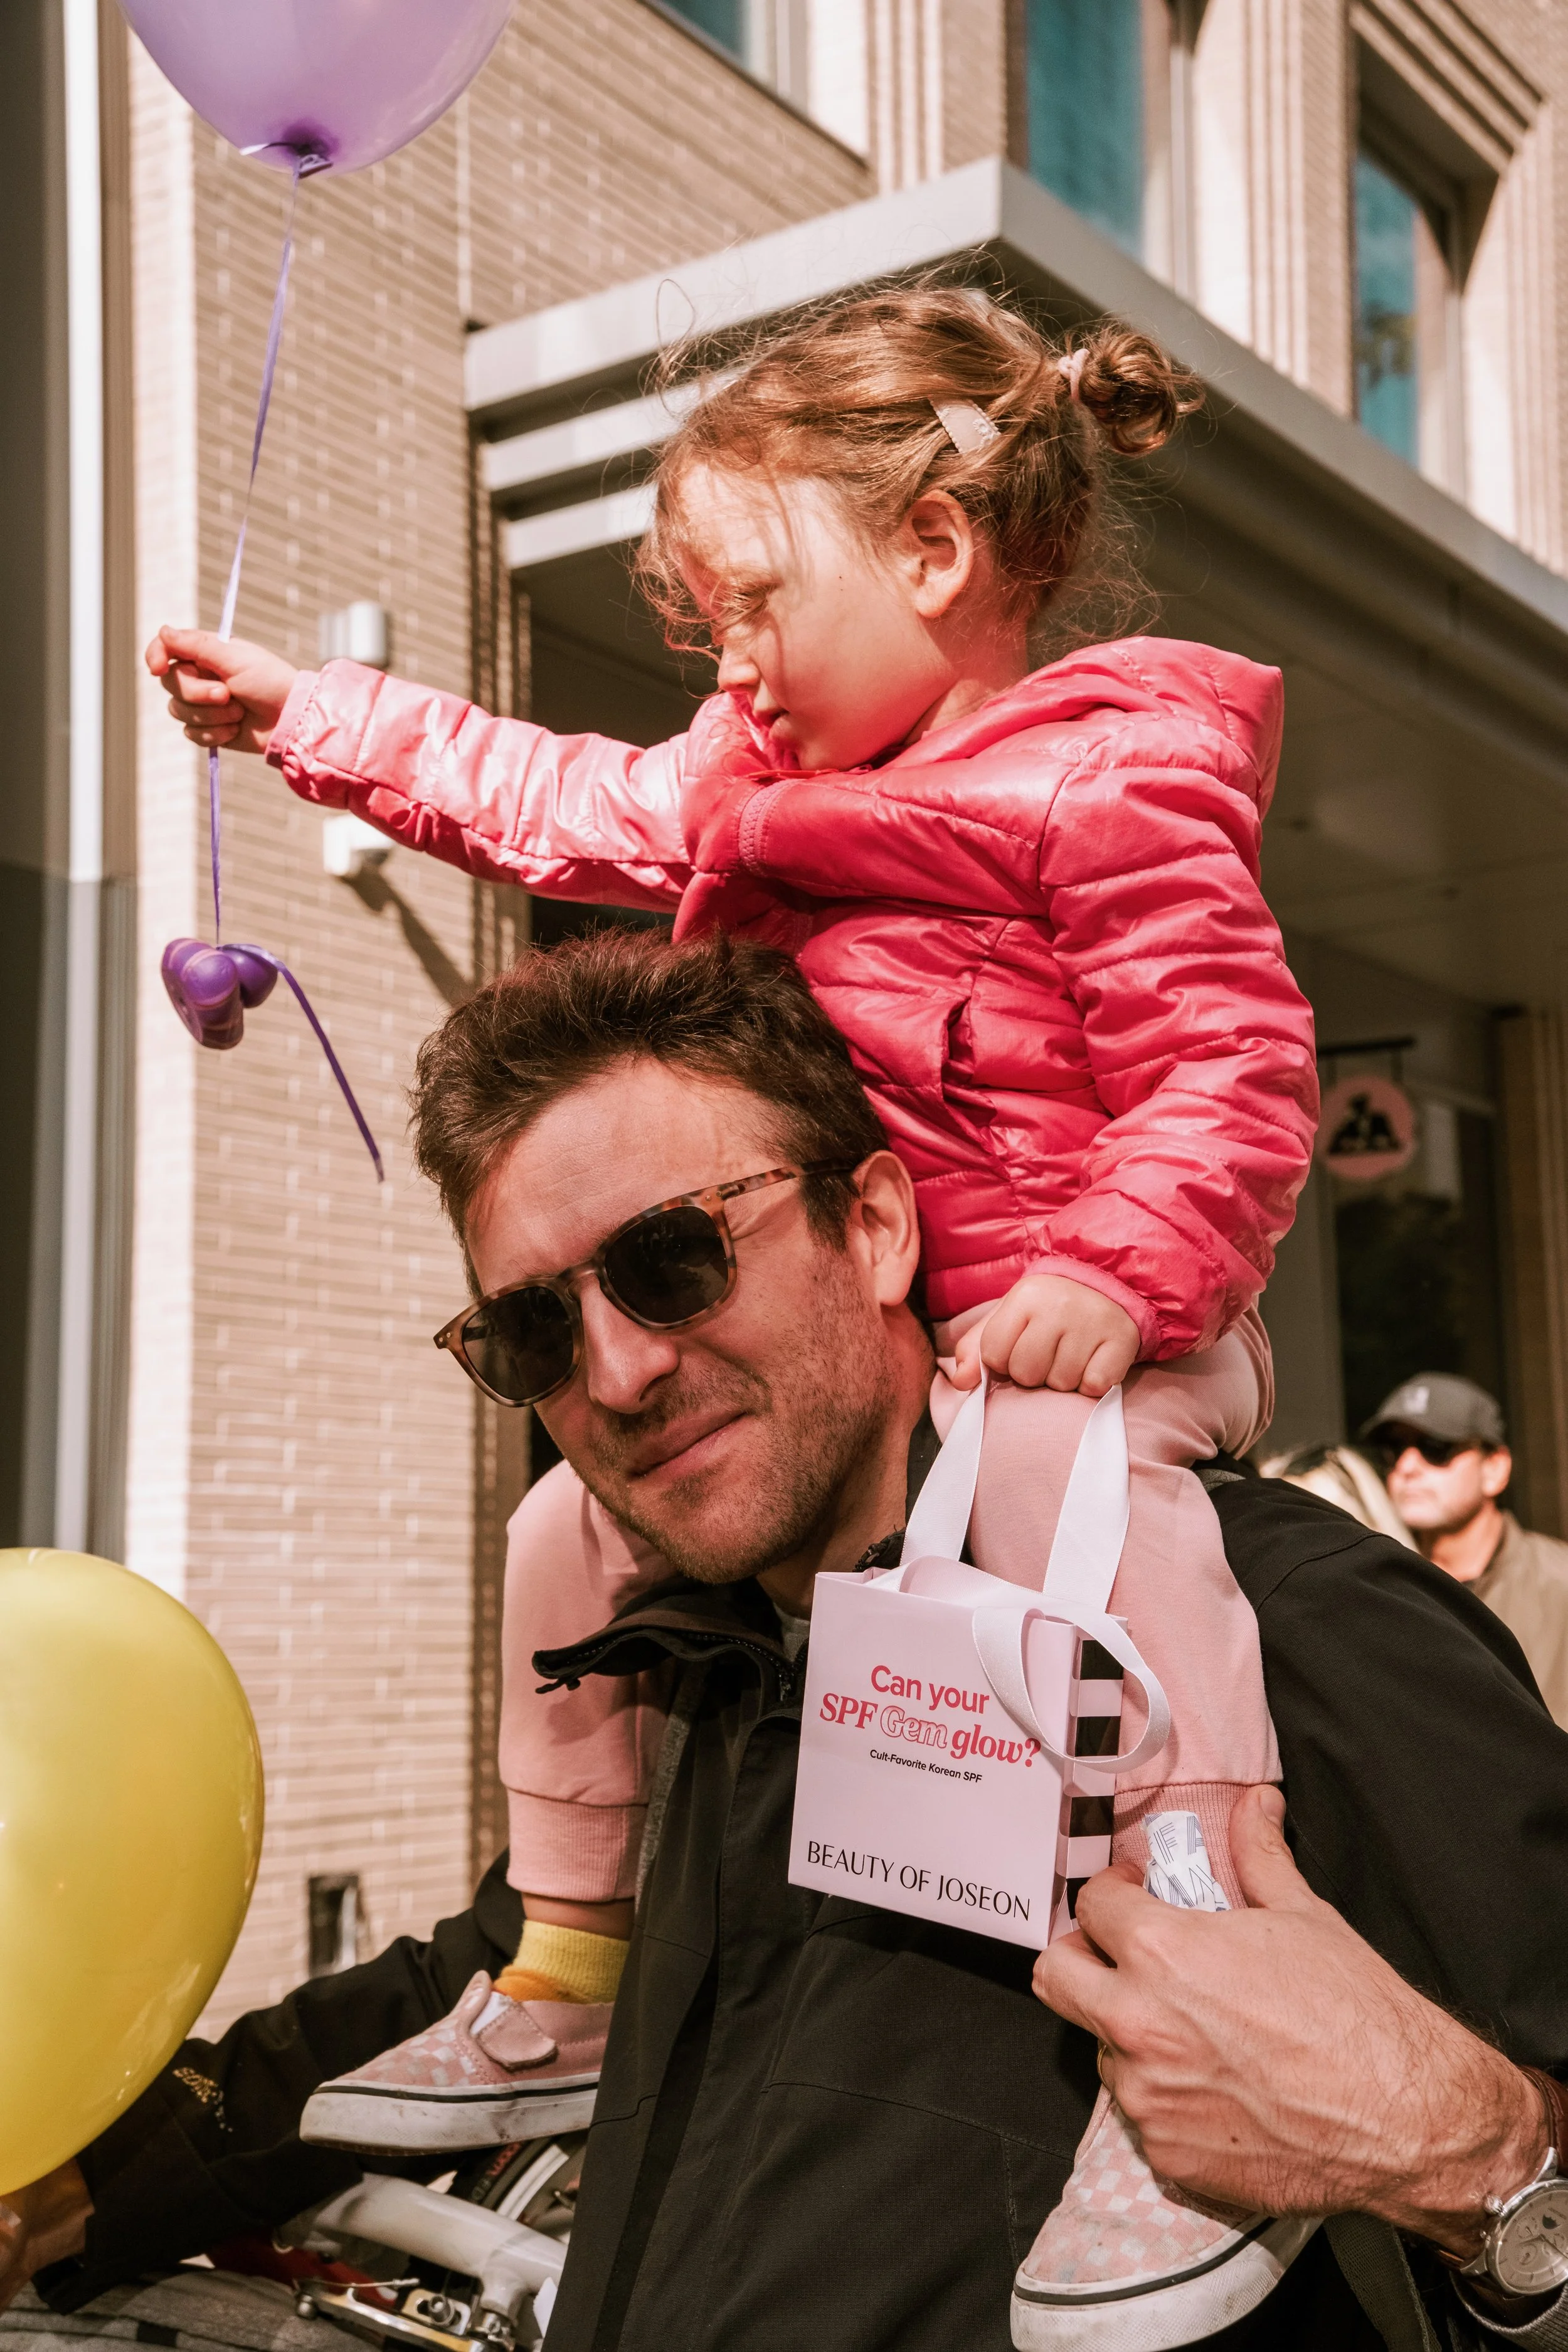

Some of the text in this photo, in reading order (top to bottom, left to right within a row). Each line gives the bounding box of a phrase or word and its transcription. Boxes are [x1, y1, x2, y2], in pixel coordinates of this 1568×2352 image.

[871, 1665, 990, 1714] Can your
[820, 1693, 1042, 1767] SPF Gem glow?
[869, 1749, 983, 1784] Cult-Favorite Korean SPF
[807, 1840, 1030, 1921] BEAUTY OF JOSEON
